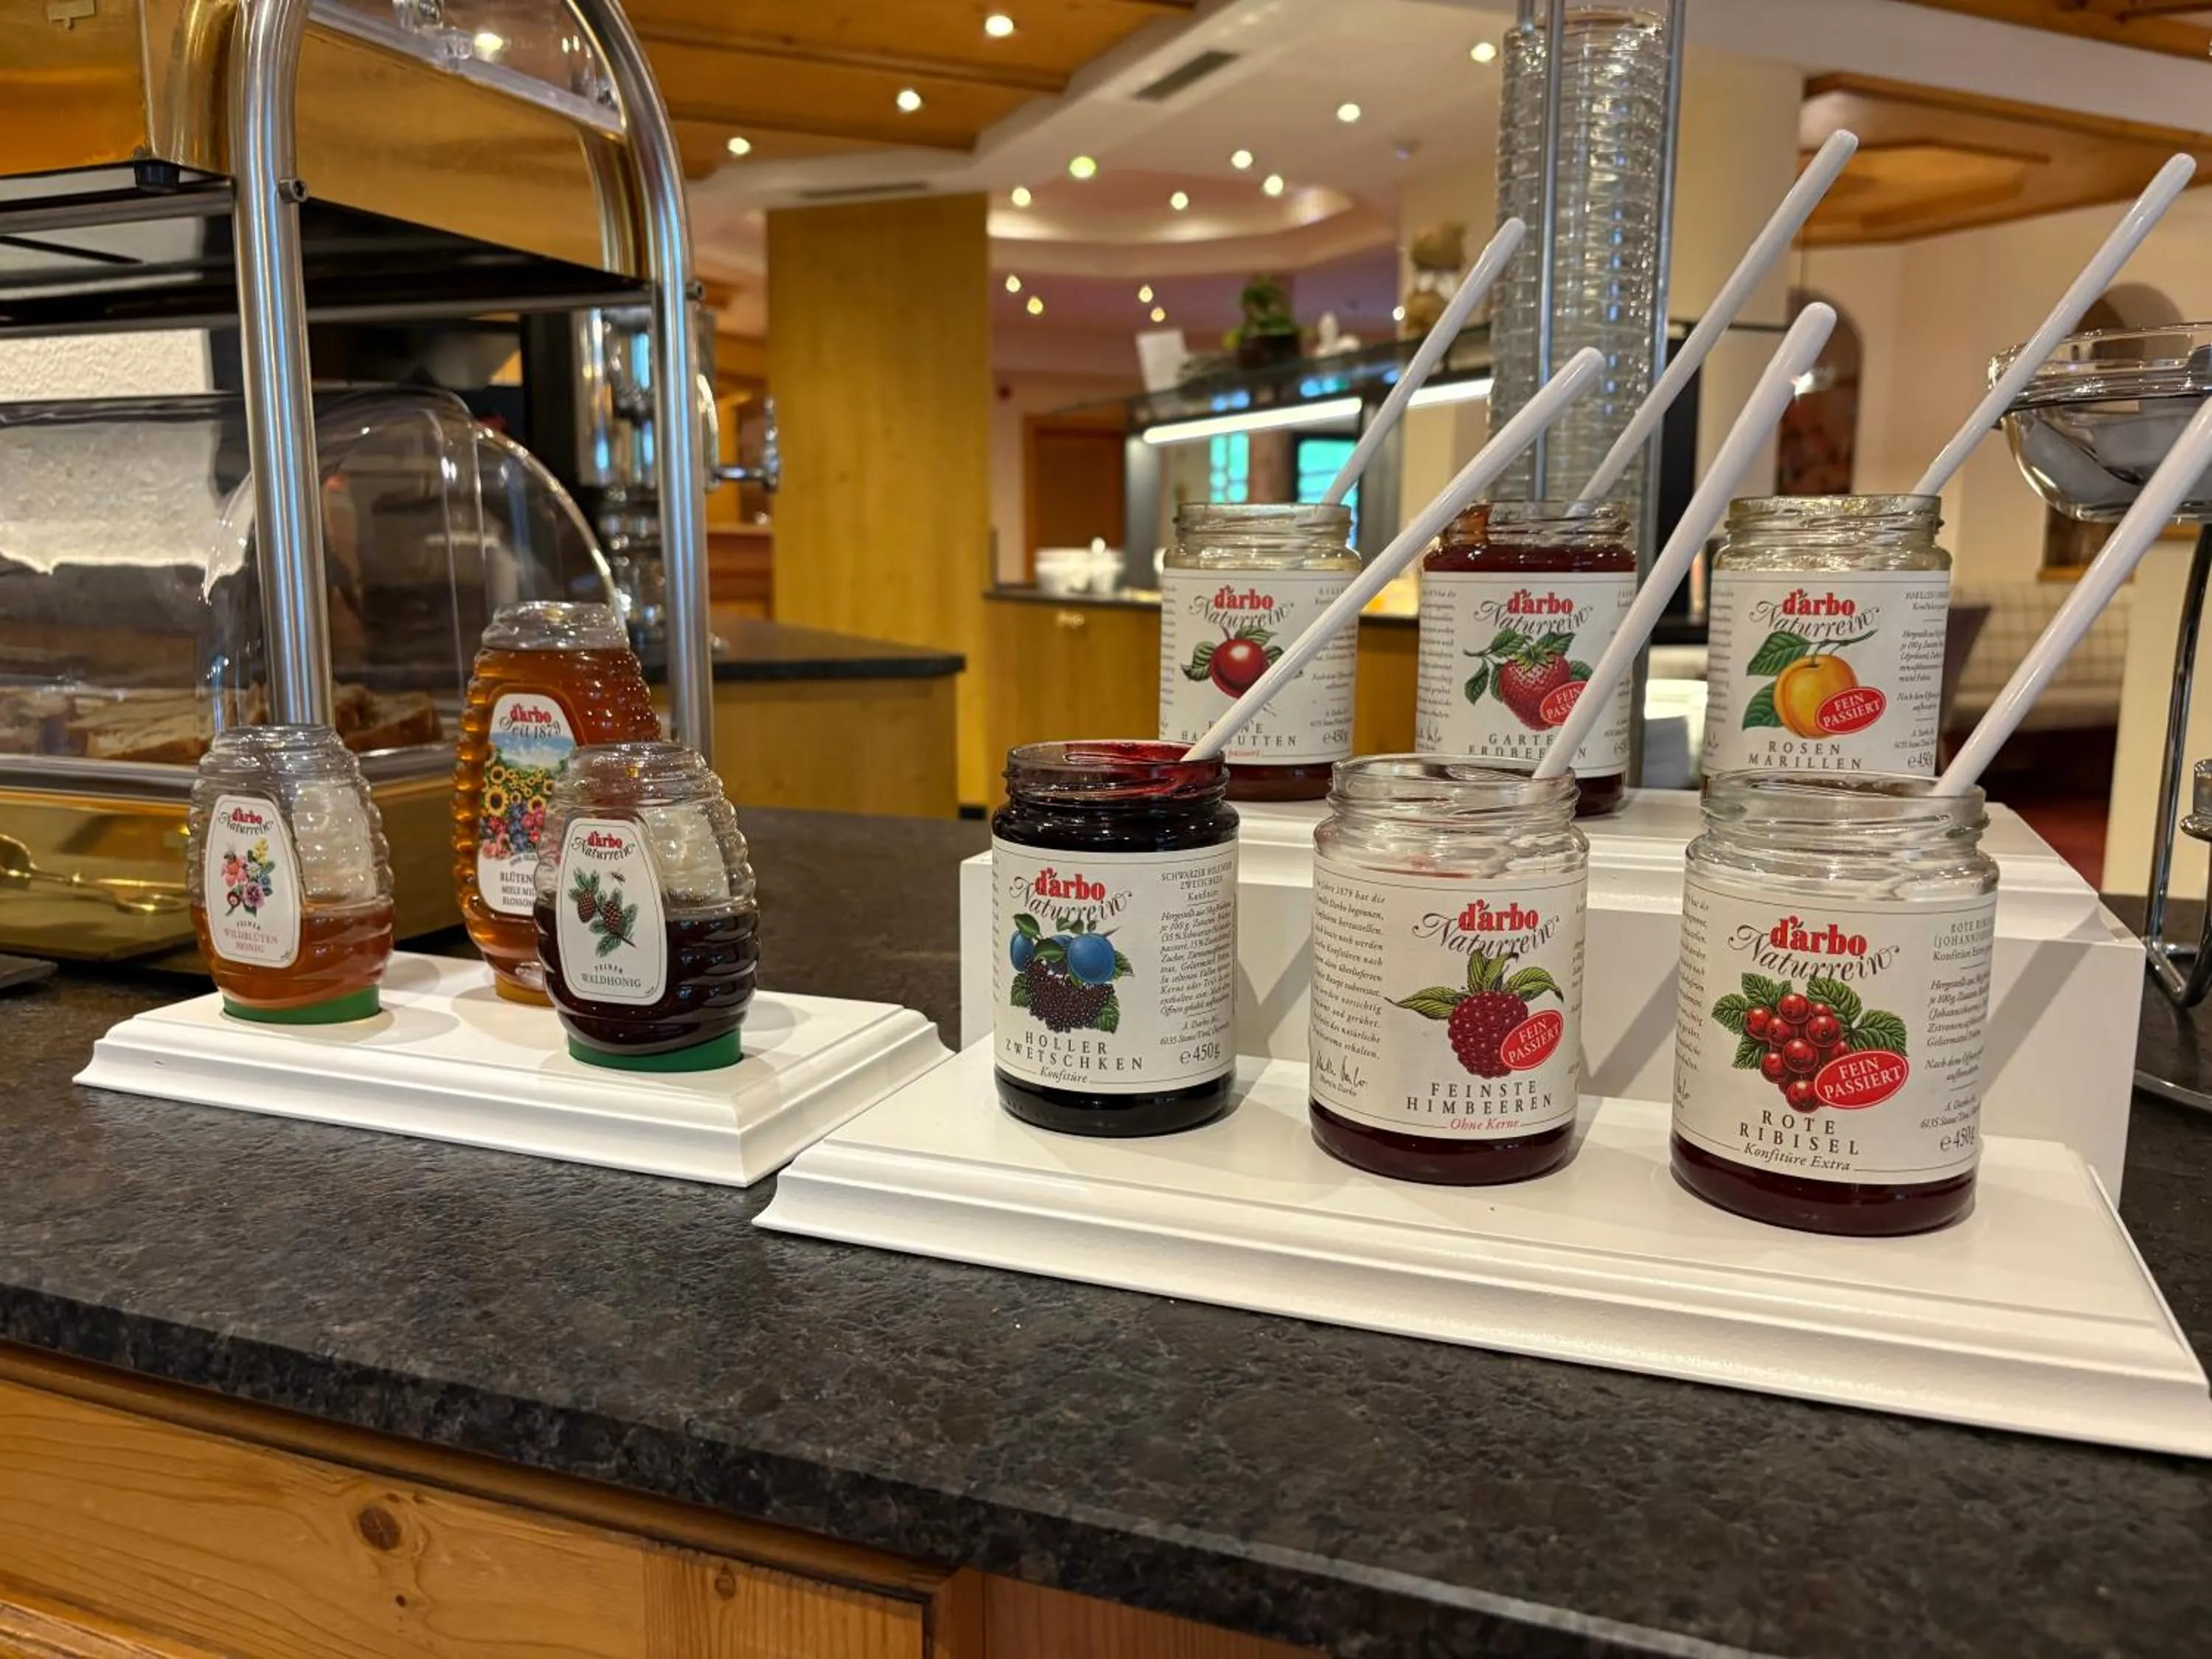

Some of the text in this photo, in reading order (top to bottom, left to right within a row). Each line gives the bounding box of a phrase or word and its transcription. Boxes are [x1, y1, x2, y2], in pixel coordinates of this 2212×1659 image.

[1189, 595, 1294, 628] Naturrein
[1473, 600, 1593, 634] Naturrein
[1749, 600, 1880, 638] Naturrein
[1823, 700, 1881, 728] PASSIERT
[1834, 693, 1865, 712] FEIN
[1208, 720, 1264, 734] FNE
[1489, 733, 1556, 745] GARTE
[1468, 744, 1587, 759] ERDBEEN
[1770, 740, 1841, 756] ROSEN
[1748, 753, 1862, 770] MARILLEN
[1009, 876, 1133, 922] Naturrein
[1412, 912, 1559, 959] Naturrein
[1728, 925, 1900, 981] Naturrein
[581, 973, 641, 988] WALDHONIG
[1025, 1031, 1107, 1054] HOLLER
[1508, 1022, 1559, 1062] PASSIERT
[1519, 1018, 1546, 1043] FEIN
[1005, 1037, 1143, 1070] ZWETSCHKEN
[1040, 1066, 1088, 1084] Konfitüre
[1839, 1057, 1880, 1080] FEIN
[1431, 1081, 1537, 1099] FEINSTE
[1823, 1066, 1902, 1099] PASSIERT
[1407, 1093, 1552, 1115] HIMBEEREN
[1450, 1118, 1519, 1131] Ohne Kerne
[1762, 1110, 1836, 1135] ROTE
[1739, 1123, 1859, 1155] RIBISEL
[1744, 1142, 1851, 1171] Konfitüre Extra
